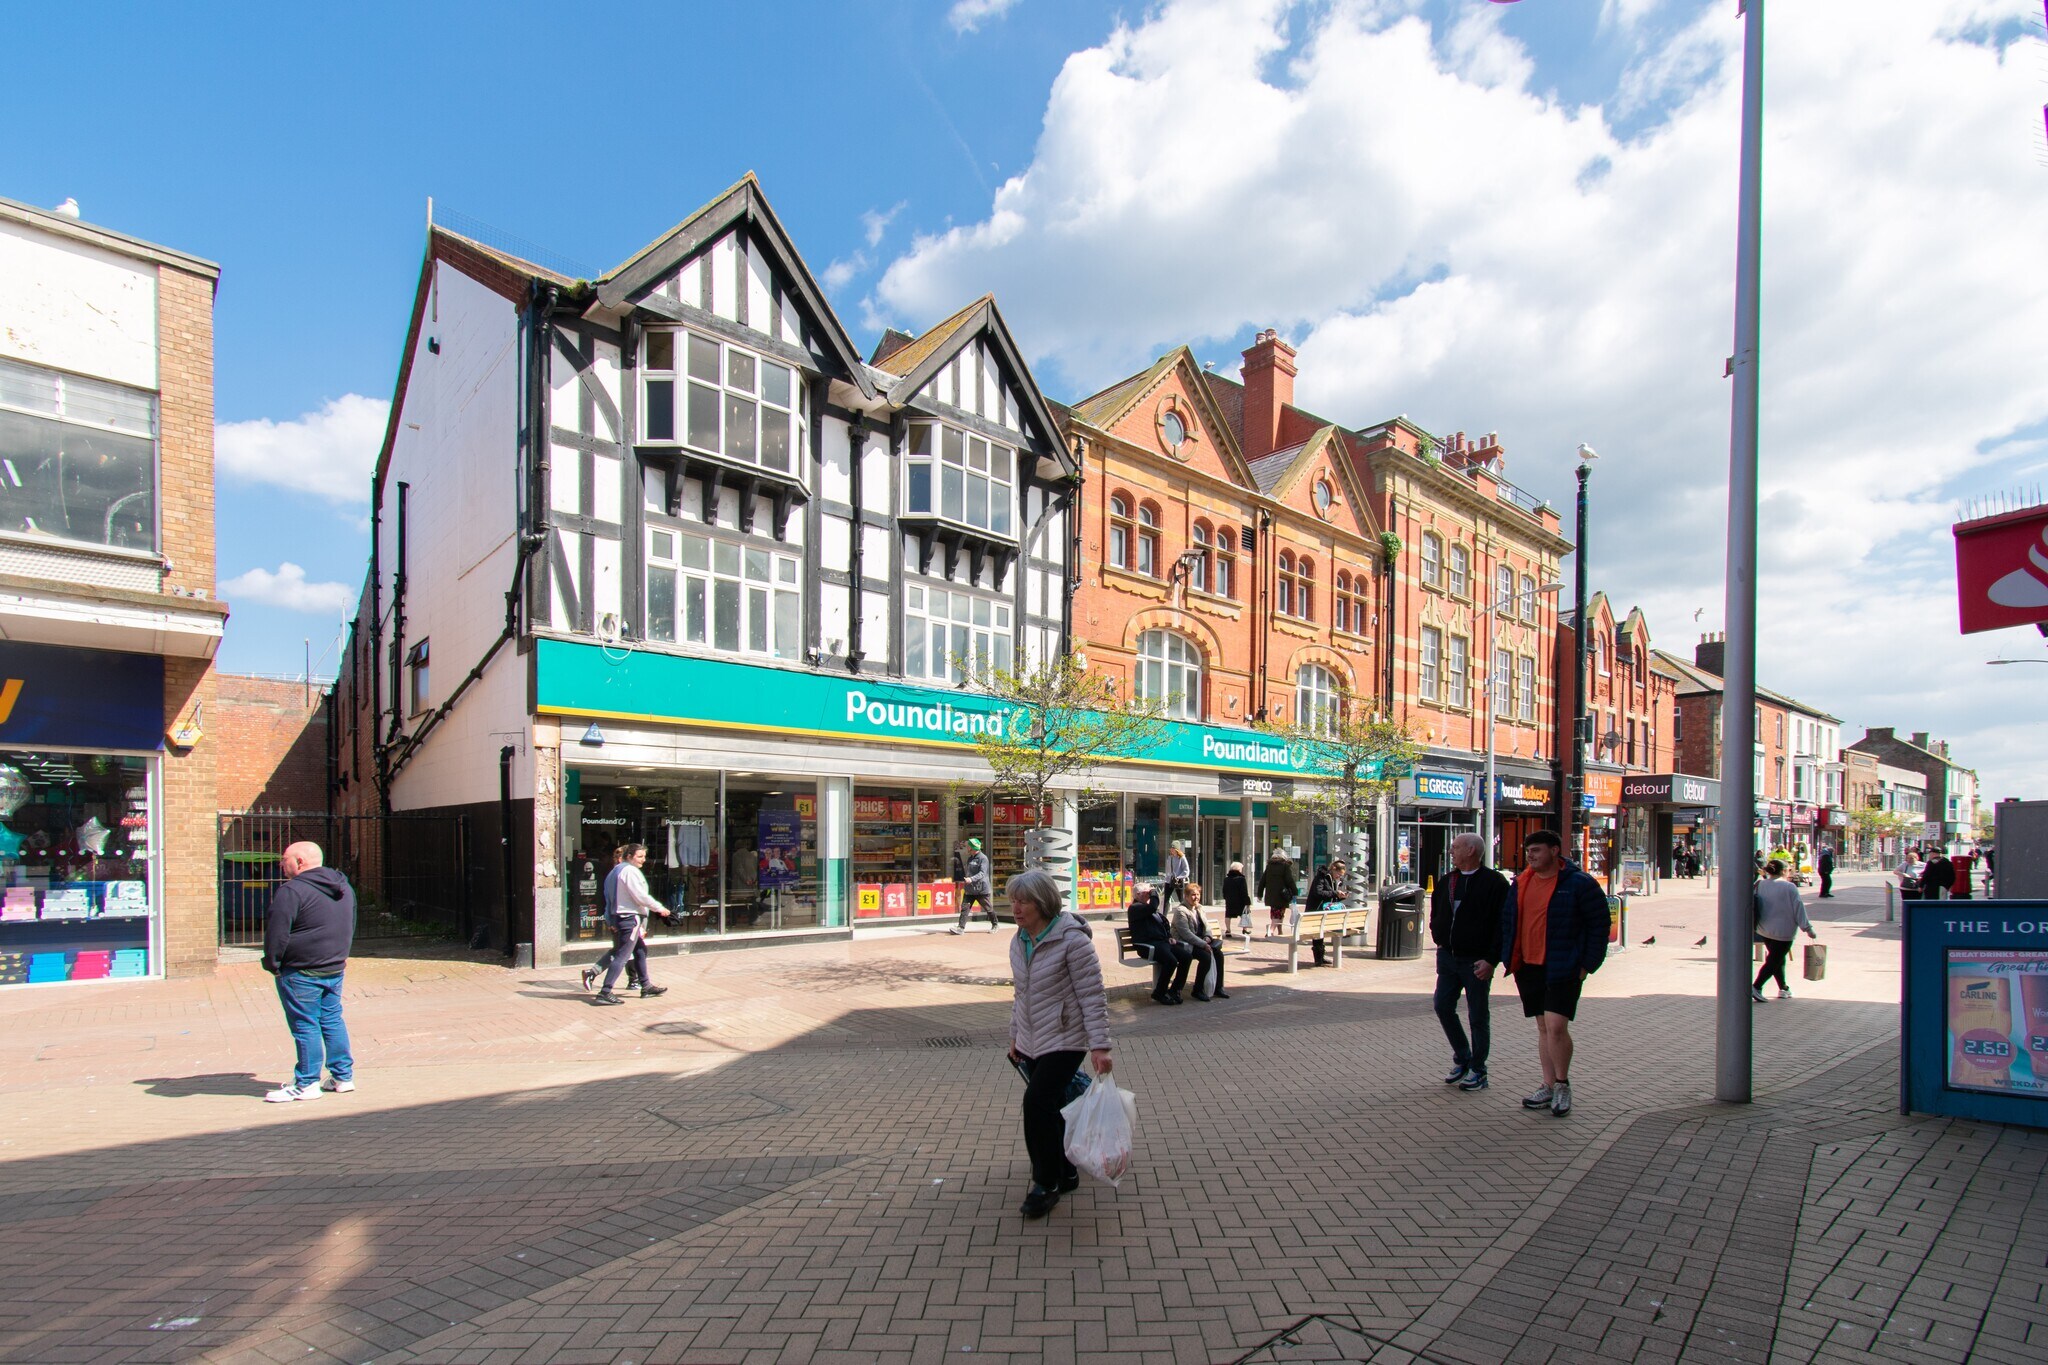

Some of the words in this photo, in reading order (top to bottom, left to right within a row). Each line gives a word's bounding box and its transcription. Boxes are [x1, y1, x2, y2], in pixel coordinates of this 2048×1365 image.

[846, 690, 1003, 736] Poundland
[1203, 735, 1288, 765] Poundland
[1428, 778, 1464, 796] GREGGS
[1624, 783, 1670, 796] detour
[1683, 779, 1707, 801] detour
[800, 802, 809, 812] £1
[854, 800, 884, 813] PRICE
[863, 894, 876, 904] £1
[887, 892, 905, 908] £1
[935, 891, 953, 906] £1
[1943, 921, 1990, 933] THE
[1987, 960, 2032, 974] Great
[1960, 990, 1997, 1000] CARLING
[1964, 1039, 2009, 1056] 2.60
[1993, 1078, 2045, 1089] WEEKDAY
